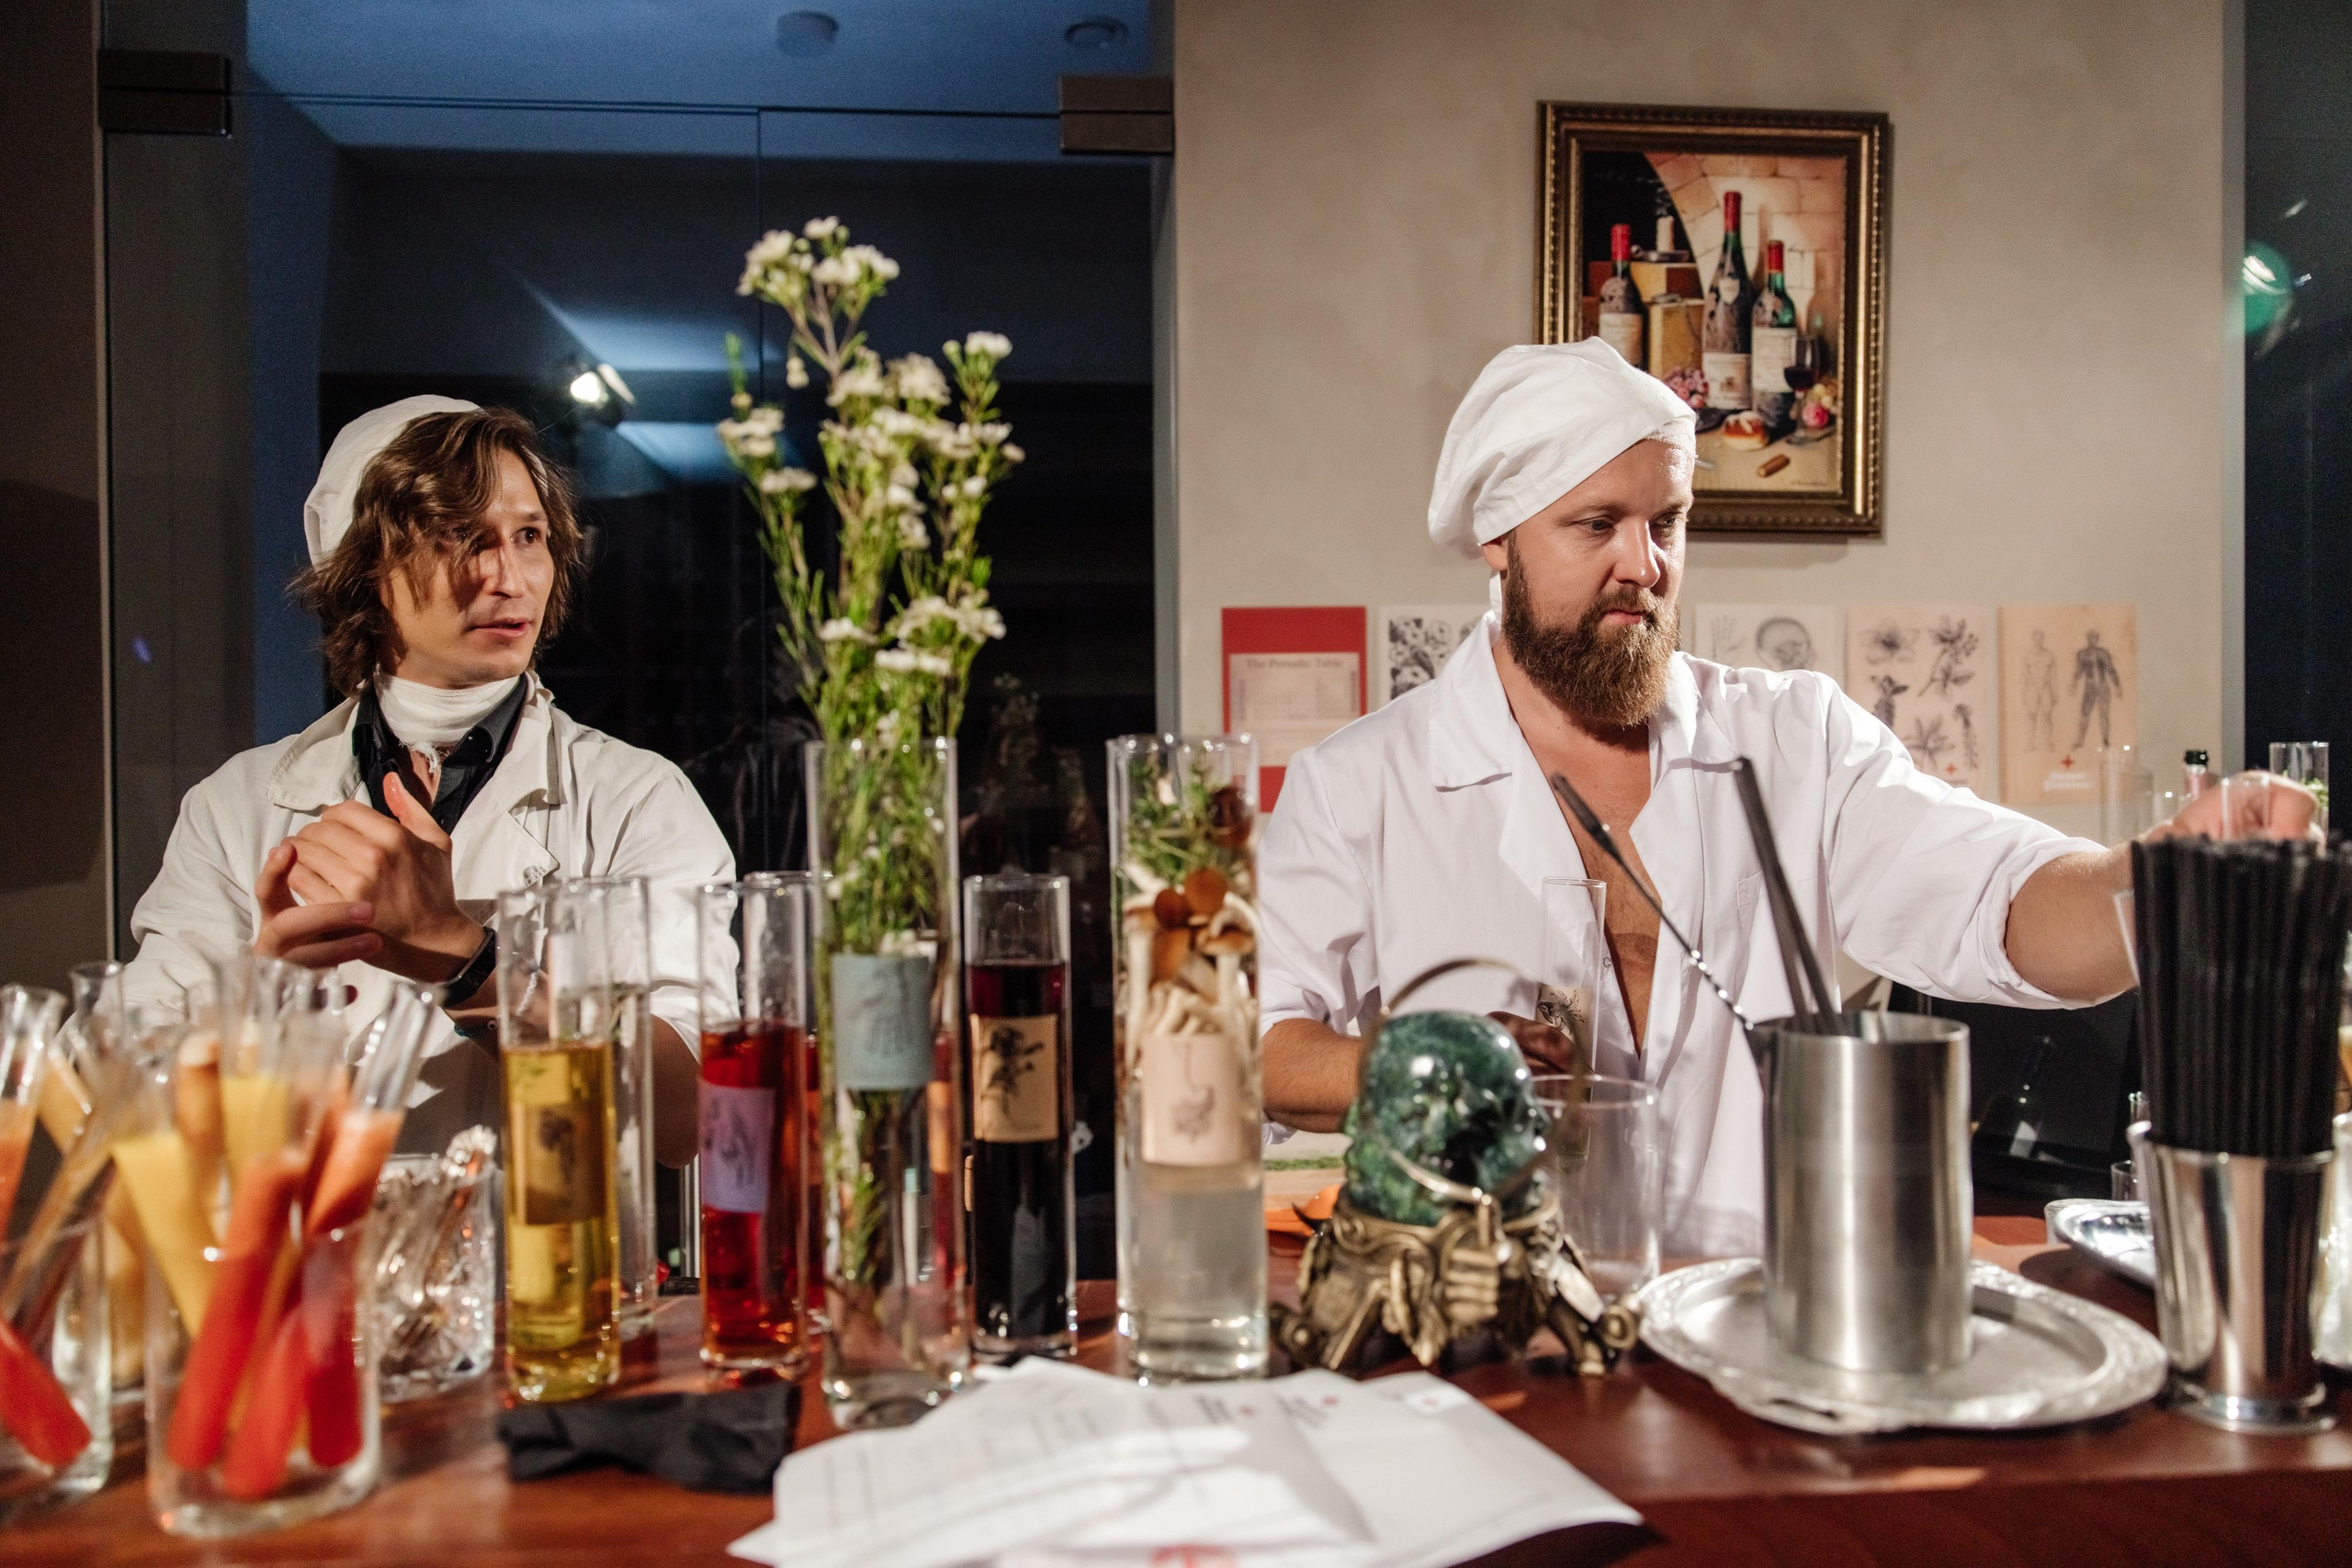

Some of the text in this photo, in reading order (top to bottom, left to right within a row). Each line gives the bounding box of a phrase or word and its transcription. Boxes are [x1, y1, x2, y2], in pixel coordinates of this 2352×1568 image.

[1246, 658, 1343, 669] The Periodic Table
